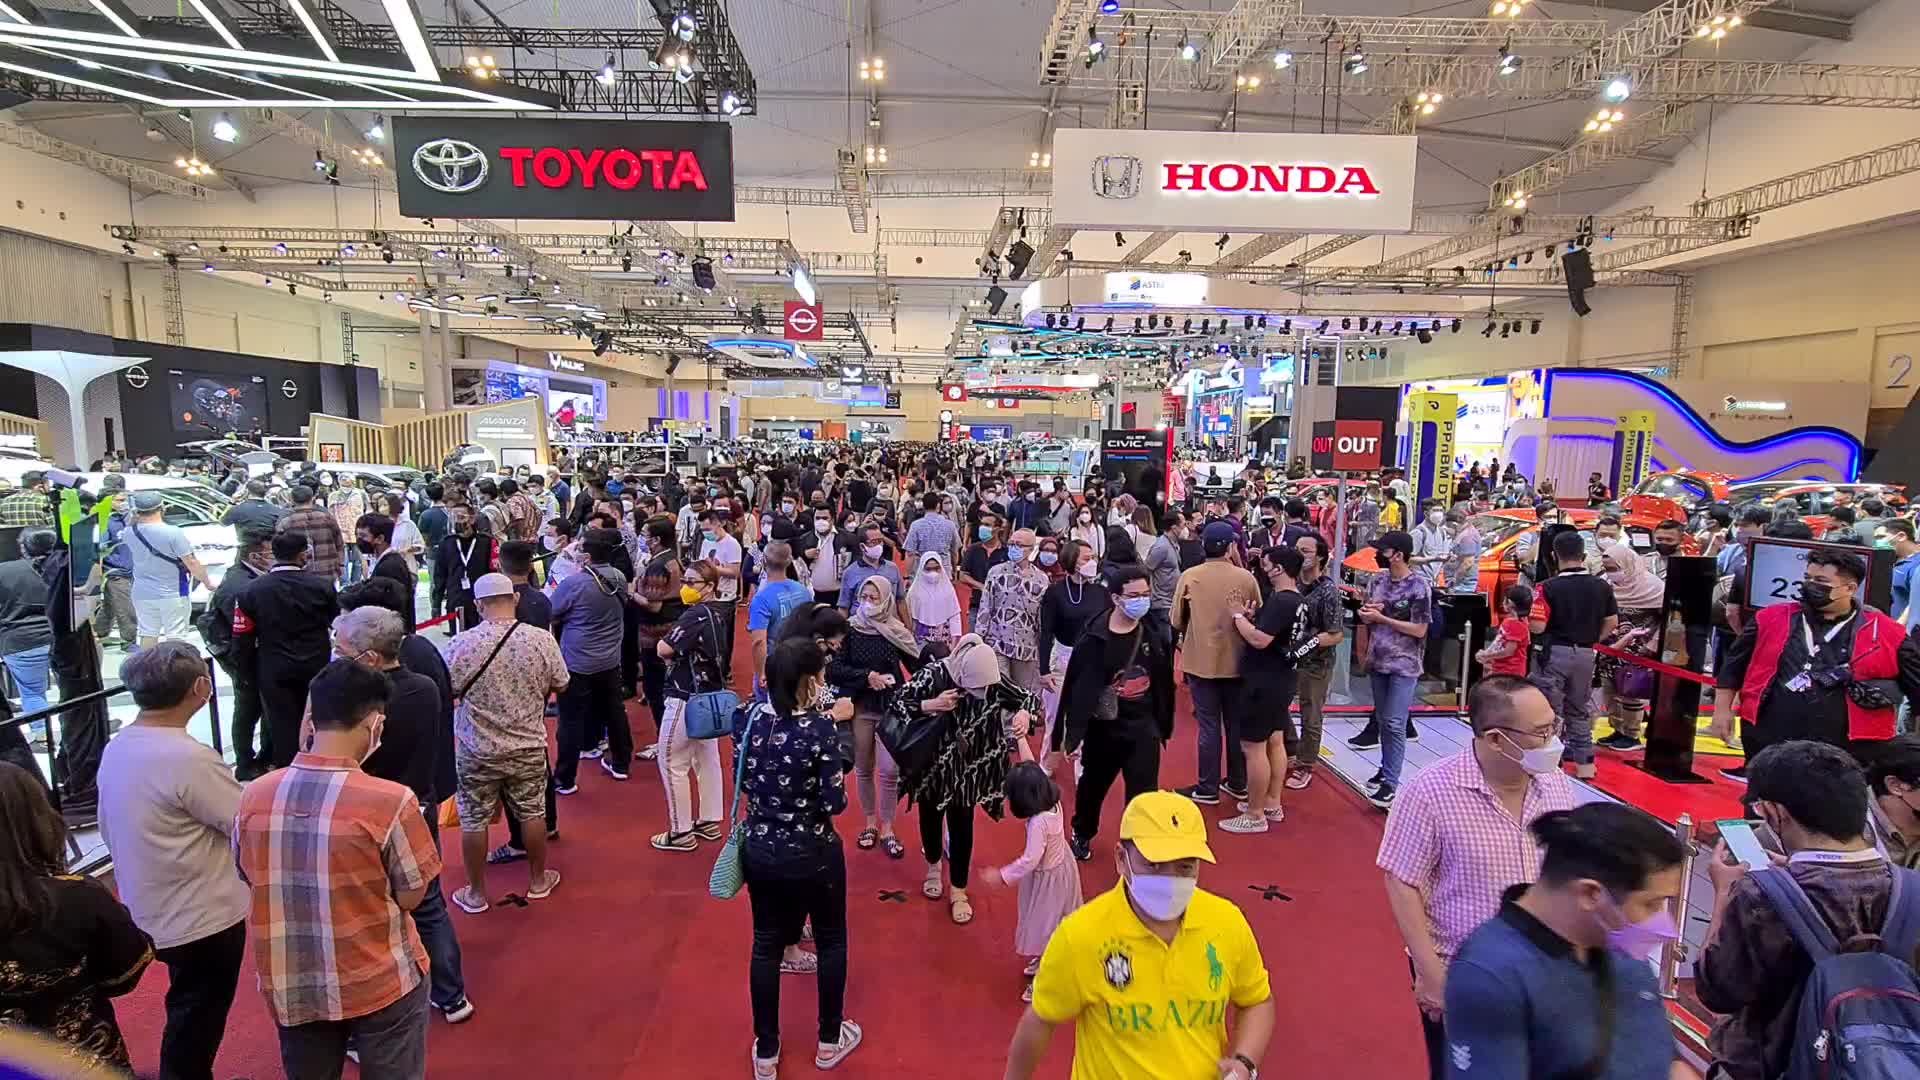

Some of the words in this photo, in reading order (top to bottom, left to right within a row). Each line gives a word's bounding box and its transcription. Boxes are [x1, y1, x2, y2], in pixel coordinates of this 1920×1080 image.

[500, 147, 708, 190] TOYOTA
[1162, 163, 1381, 195] HONDA
[1885, 354, 1912, 389] 2
[479, 415, 527, 425] AVANZA
[1107, 440, 1142, 448] CIVIC
[1313, 437, 1333, 453] OUT
[1338, 436, 1378, 454] OUT
[1439, 421, 1453, 479] PPnBM
